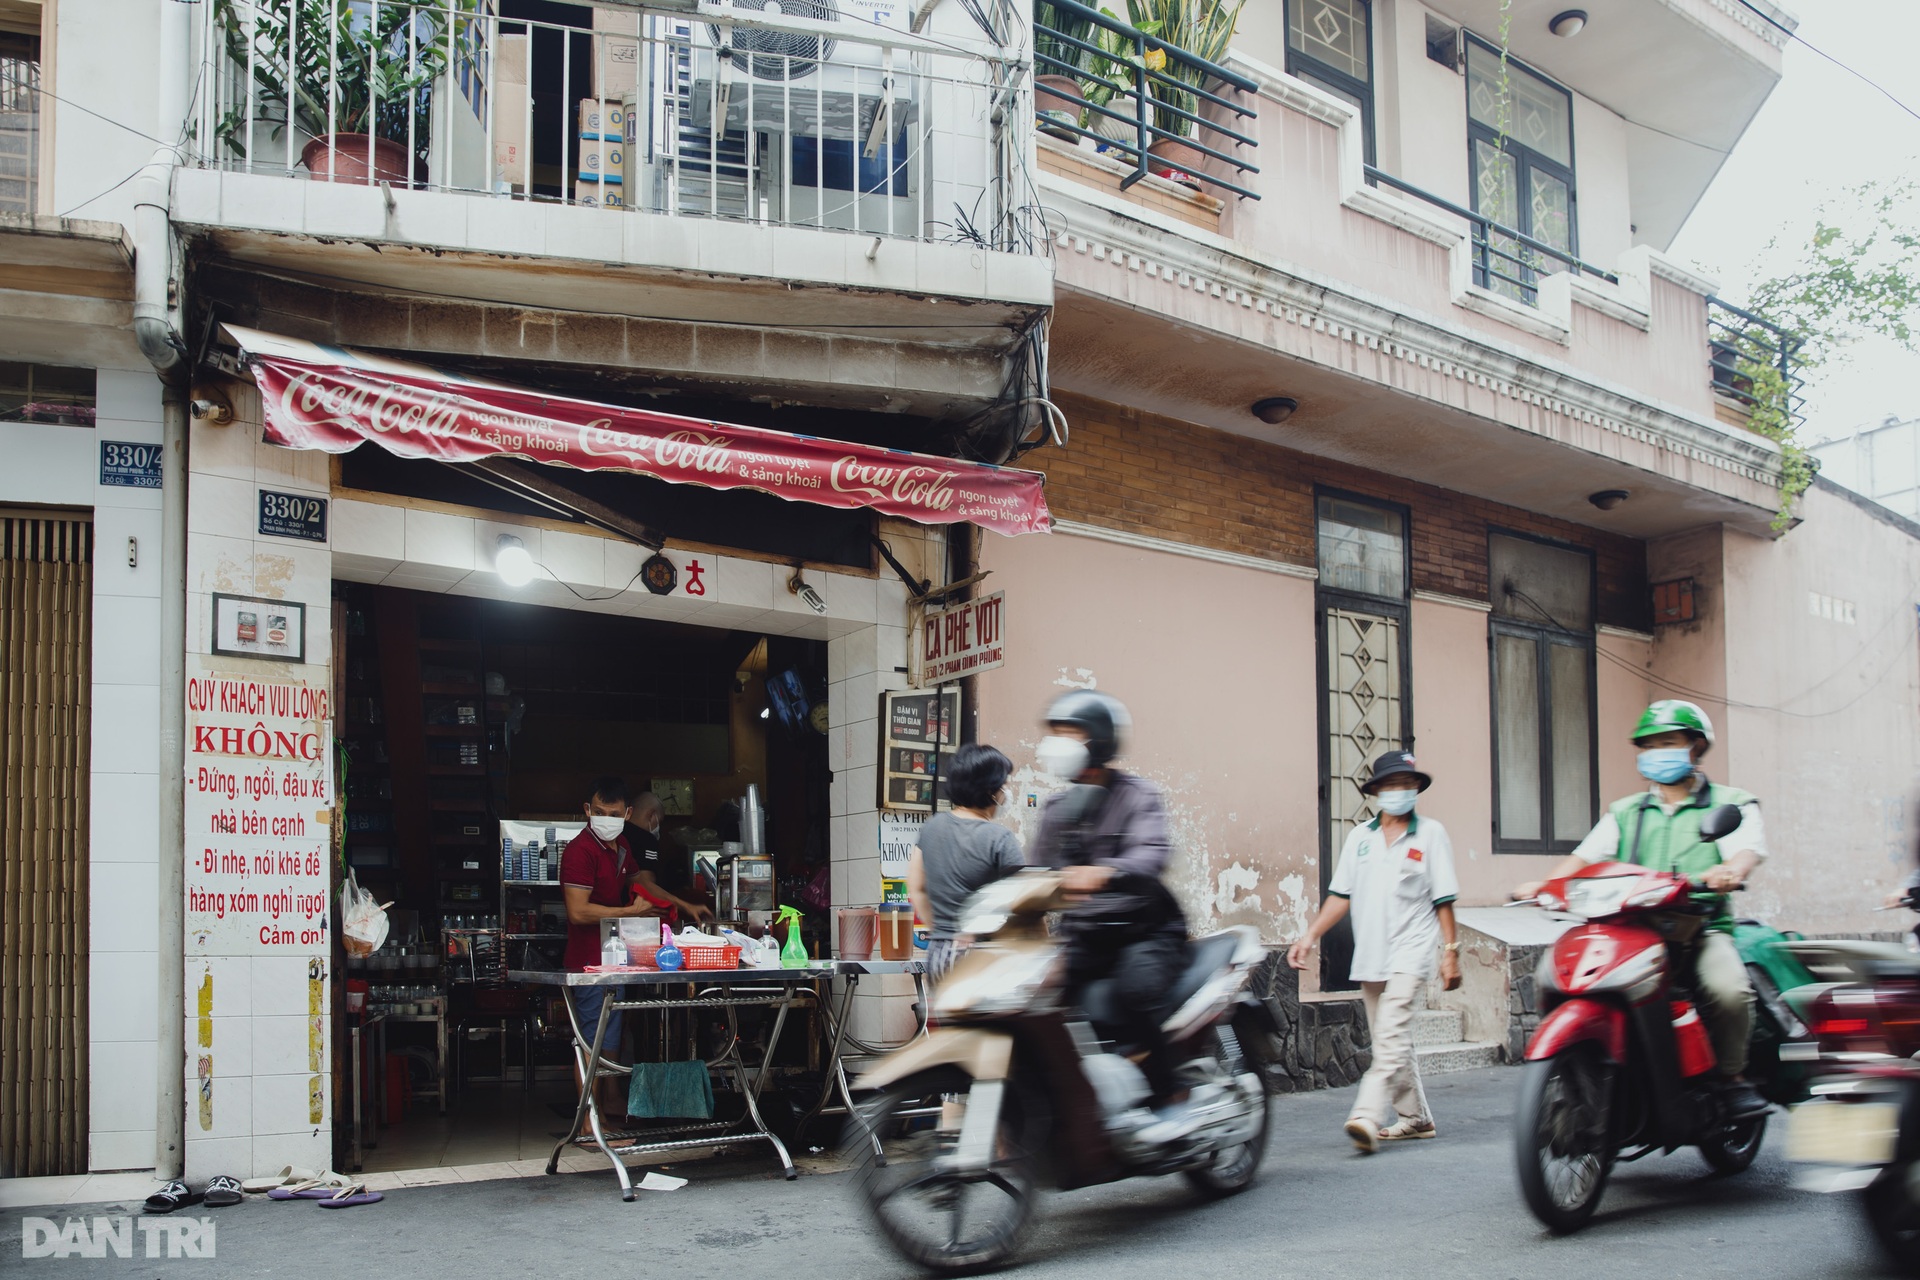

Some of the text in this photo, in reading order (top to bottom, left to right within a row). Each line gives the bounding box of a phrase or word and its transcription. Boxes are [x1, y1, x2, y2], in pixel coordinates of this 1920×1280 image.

[855, 0, 895, 10] INVERTER
[469, 411, 554, 433] ngon tuyệt
[470, 427, 569, 453] & sảng khoái
[105, 444, 163, 469] 330/4
[737, 451, 773, 463] ngon
[105, 475, 115, 483] SỐ
[133, 477, 162, 486] 330/2
[739, 464, 822, 489] & sảng khoái
[264, 494, 320, 523] 330/2
[959, 489, 1019, 509] ngon tuyệt
[288, 521, 305, 529] 330/1
[958, 504, 1032, 522] & sảng khoái
[925, 596, 1002, 661] CÀ PHÊ VỢT
[945, 658, 961, 675] PHAN
[961, 653, 978, 670] ĐÌNH
[979, 647, 1002, 666] PHÙNG
[188, 671, 327, 720] QUÝ KHÁCH VUI LÒNG
[893, 715, 922, 726] THỜI GIAN
[896, 705, 918, 717] ĐẬM VỊ
[192, 721, 324, 761] KHÔNG
[198, 767, 240, 801] Đứng,
[244, 766, 279, 802] ngồi,
[283, 772, 308, 802] đậu
[311, 779, 324, 799] xe
[211, 808, 305, 841] nhà bên cạnh
[881, 808, 929, 824] CÀ PHÊ
[882, 837, 912, 862] KHÔNG
[204, 848, 218, 874] Đi
[222, 849, 250, 880] nhẹ,
[254, 850, 274, 875] nói
[279, 851, 301, 876] khẽ
[305, 845, 321, 876] để
[190, 886, 325, 920] hàng xóm nghỉ ngơi
[259, 924, 325, 945] Cảm ơn!
